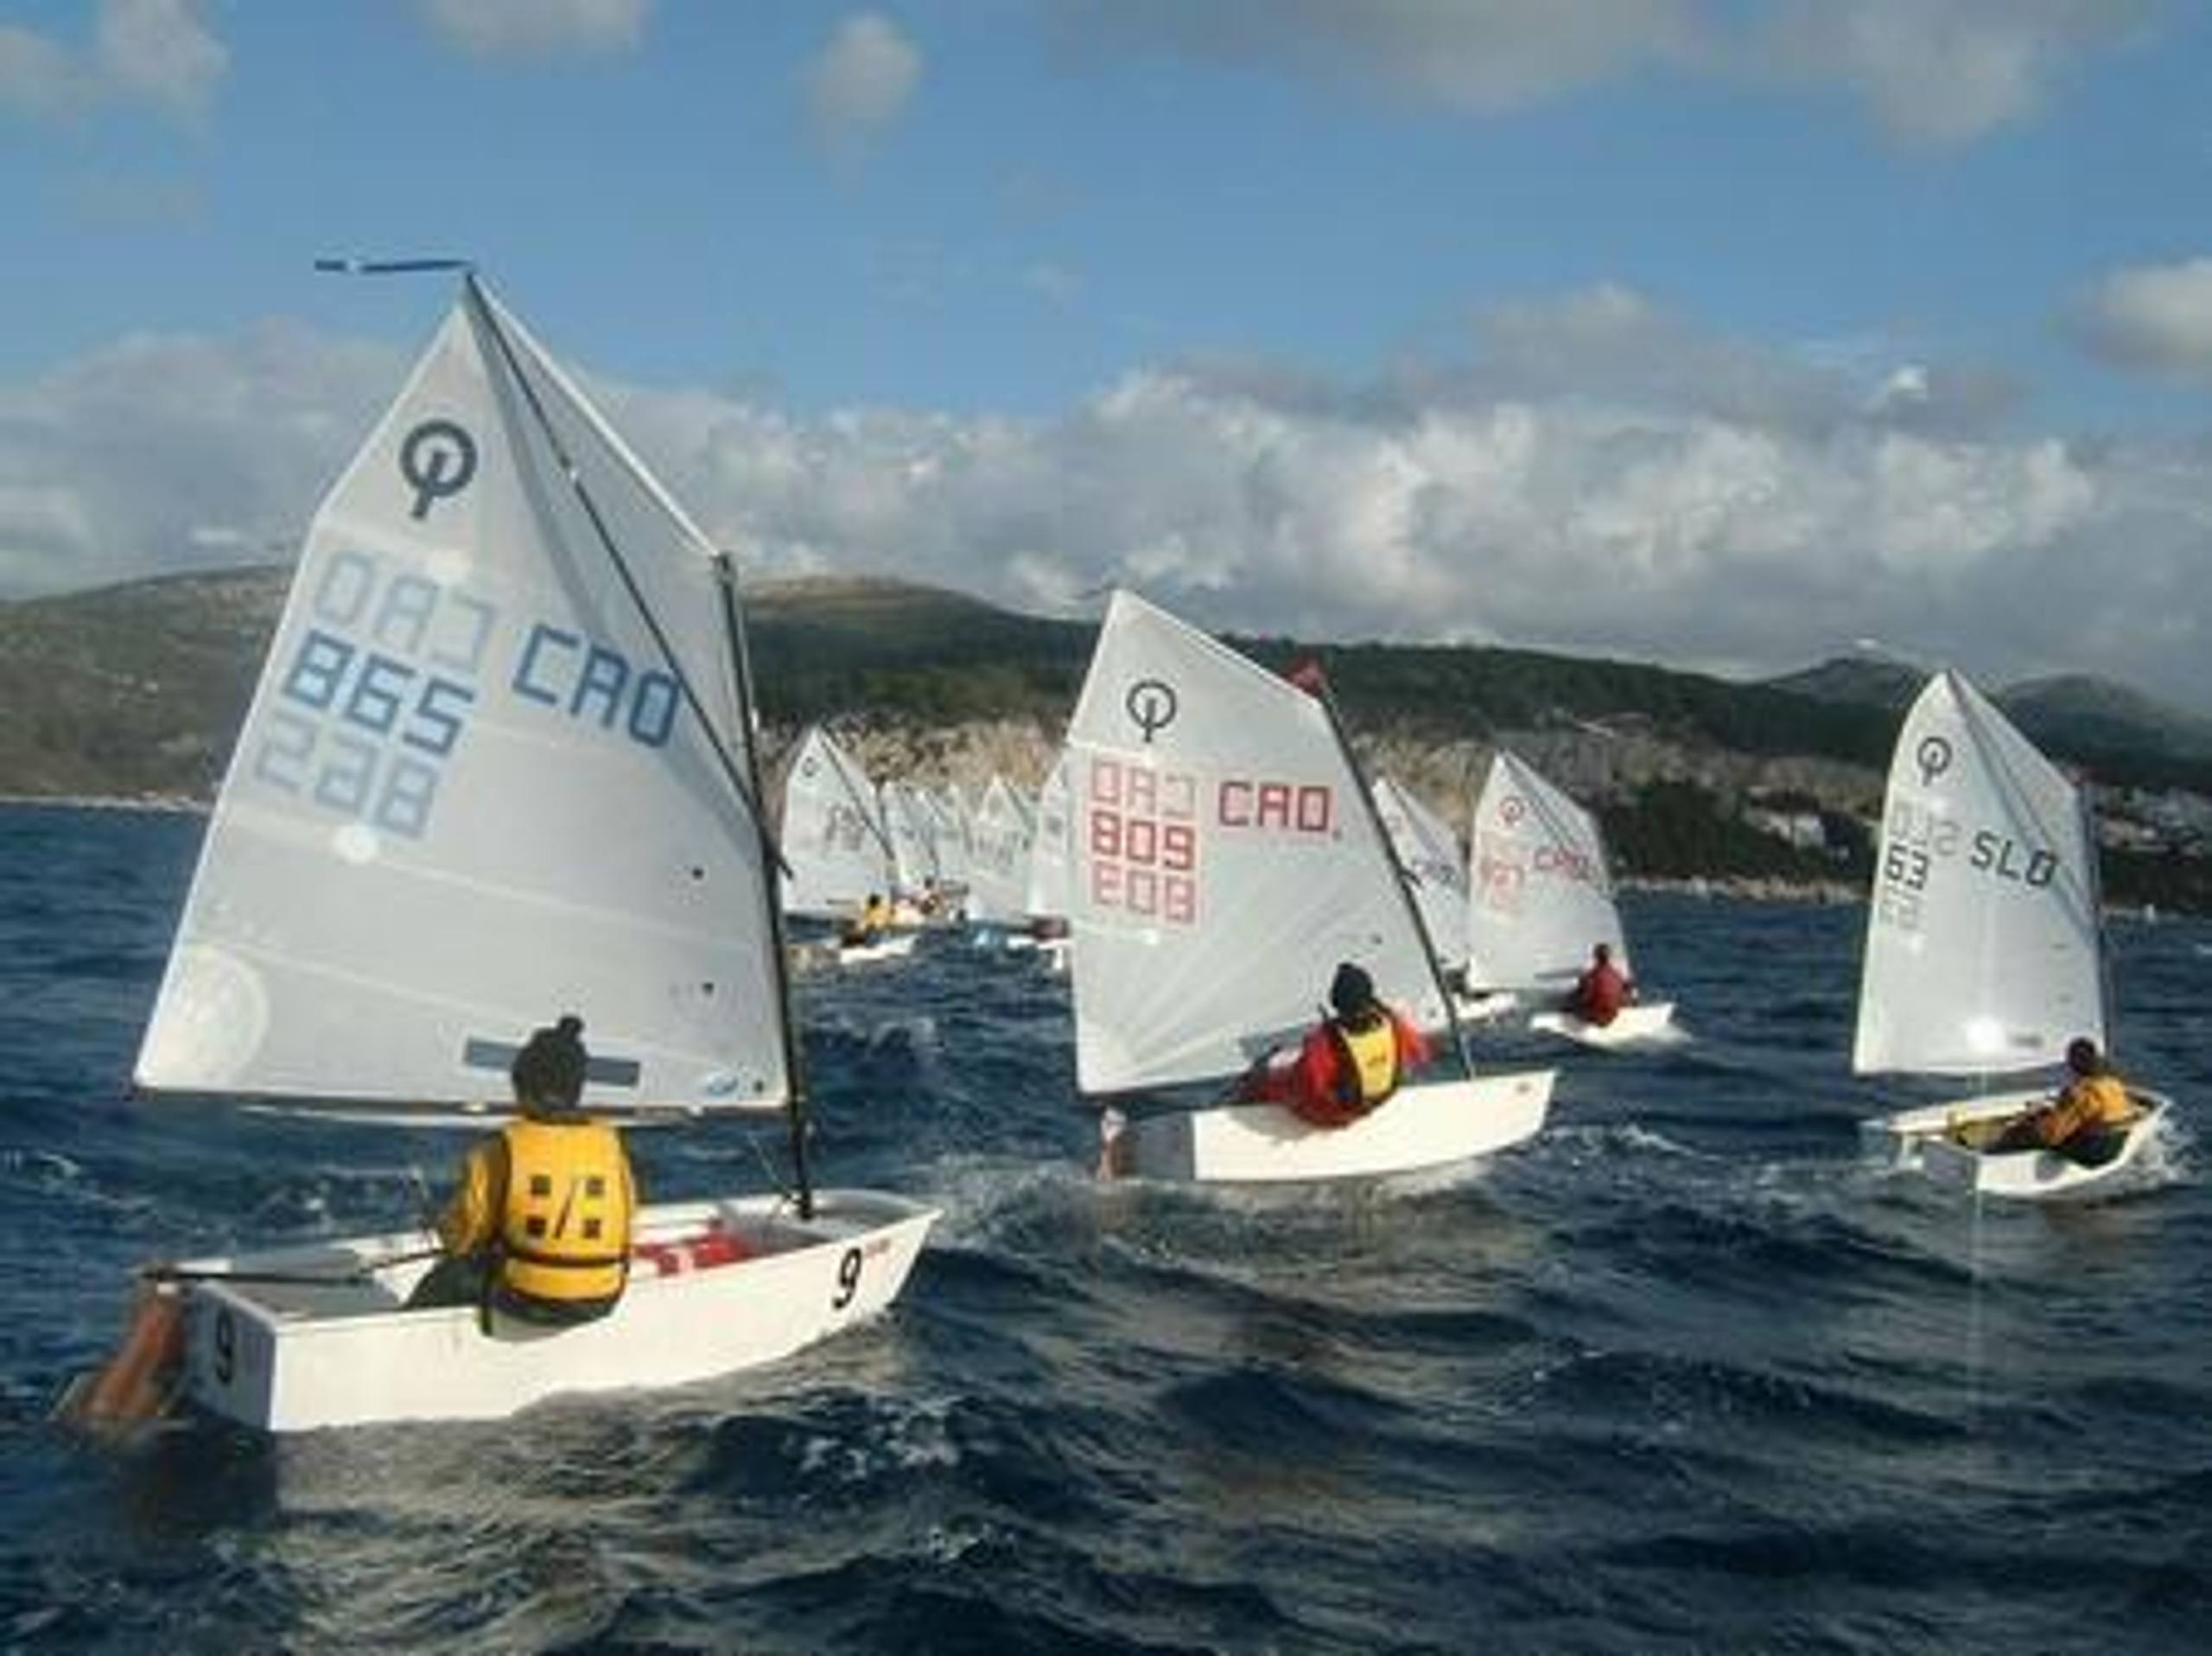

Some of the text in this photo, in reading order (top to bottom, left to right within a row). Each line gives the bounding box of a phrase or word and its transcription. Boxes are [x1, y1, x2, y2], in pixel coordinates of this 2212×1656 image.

[285, 629, 475, 756] 865
[512, 623, 682, 749] CRO
[1219, 781, 1331, 832] CRO
[1091, 809, 1196, 871] 809
[1970, 829, 2057, 888] SLO
[832, 1247, 862, 1310] 9
[215, 1309, 236, 1385] 9
